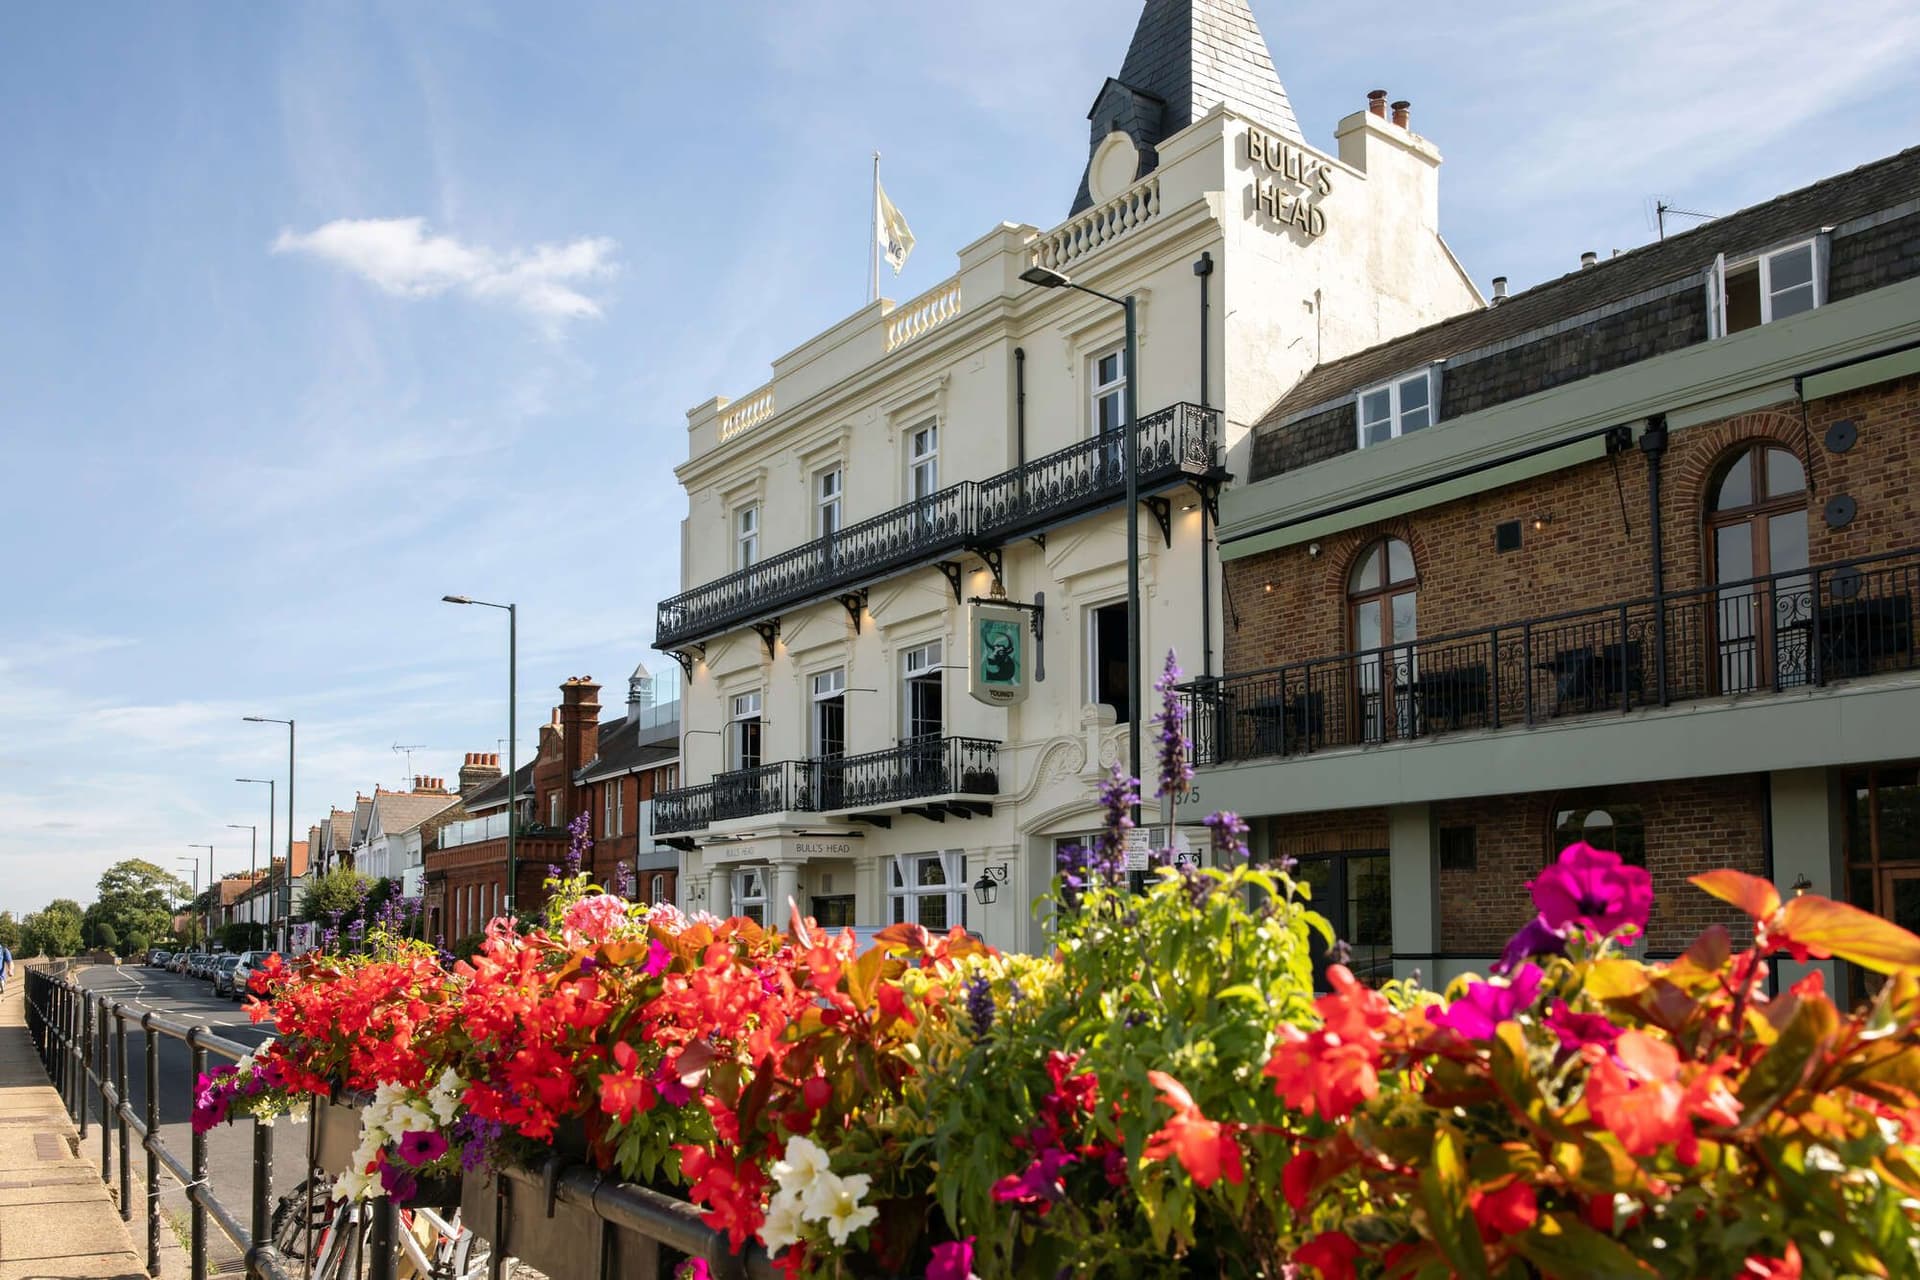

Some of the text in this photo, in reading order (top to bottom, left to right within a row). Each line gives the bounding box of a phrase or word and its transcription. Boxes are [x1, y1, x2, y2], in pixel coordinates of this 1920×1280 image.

[1247, 127, 1333, 196] BULL'S
[1255, 178, 1327, 237] HEAD
[826, 844, 850, 853] HEAD
